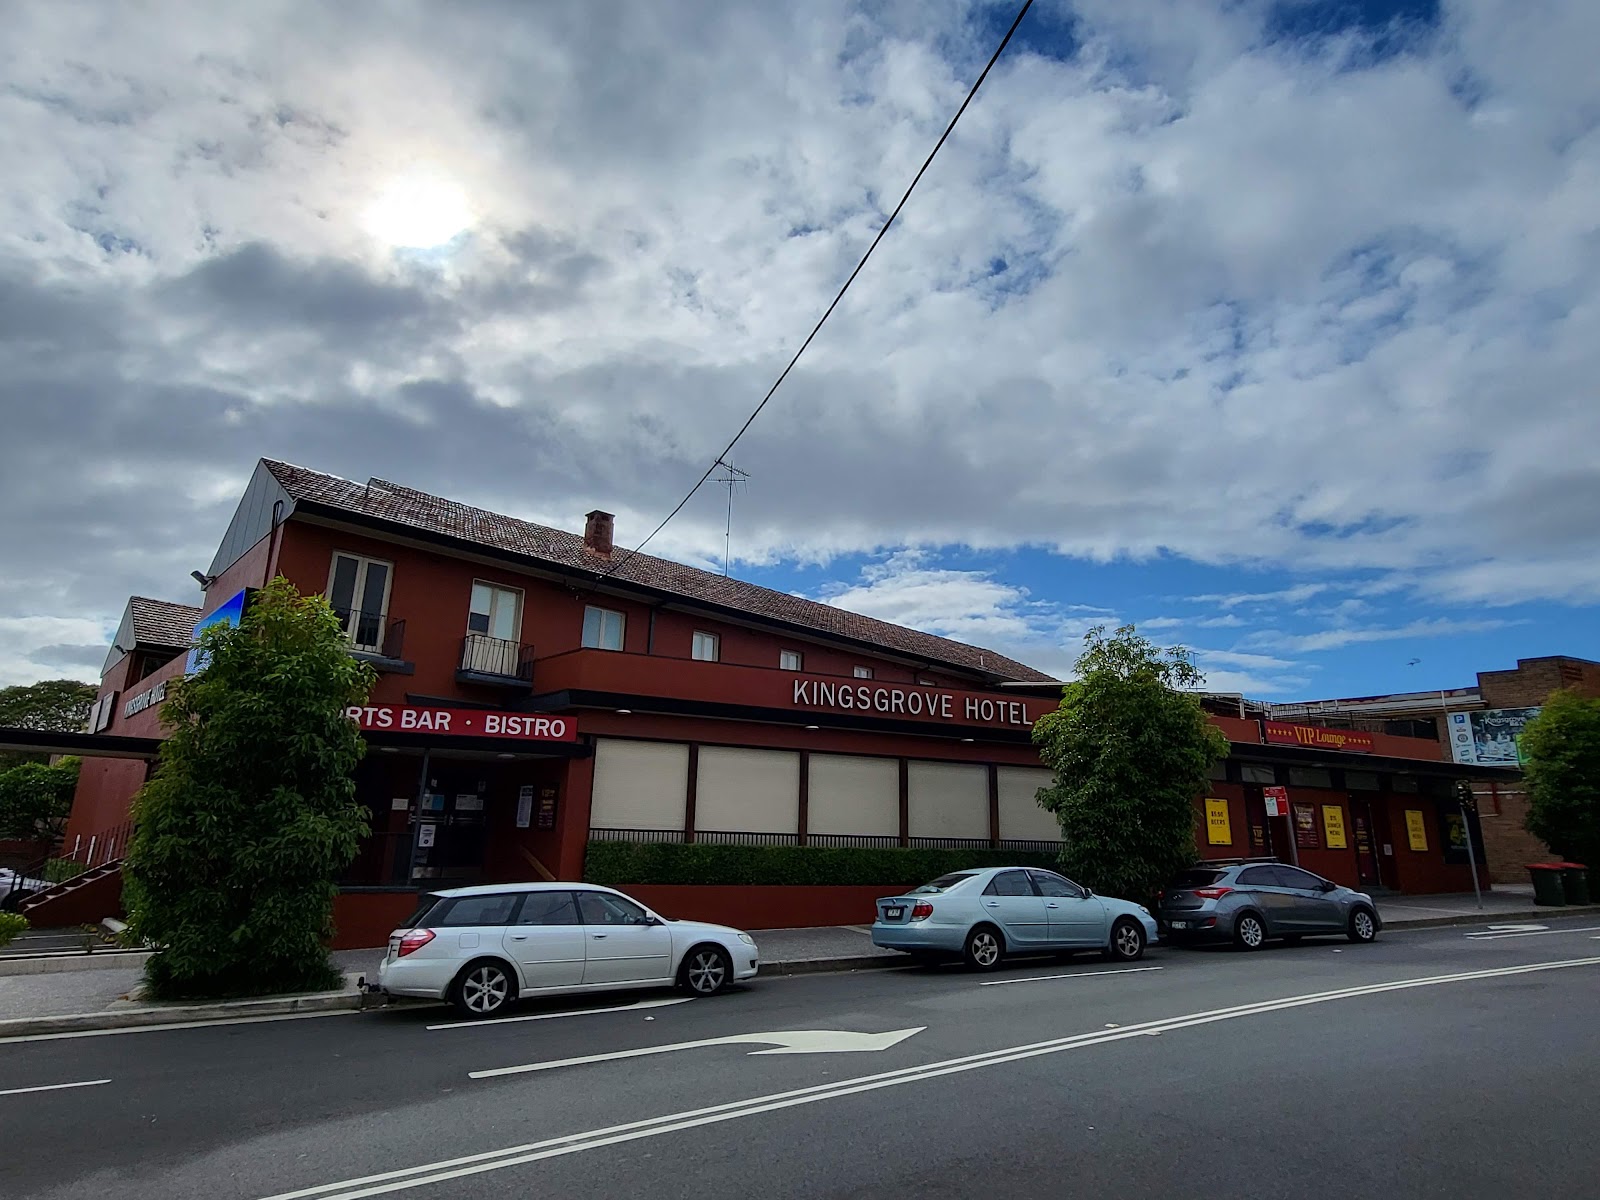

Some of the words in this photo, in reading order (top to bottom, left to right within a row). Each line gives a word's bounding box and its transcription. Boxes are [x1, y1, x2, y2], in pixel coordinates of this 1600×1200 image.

[793, 679, 954, 718] KINGSGROVE
[965, 697, 1033, 726] HOTEL
[340, 706, 393, 728] RTS
[400, 709, 452, 731] BAR
[485, 714, 566, 738] BISTRO
[1293, 725, 1315, 745] VIP
[1315, 728, 1347, 748] Lounge
